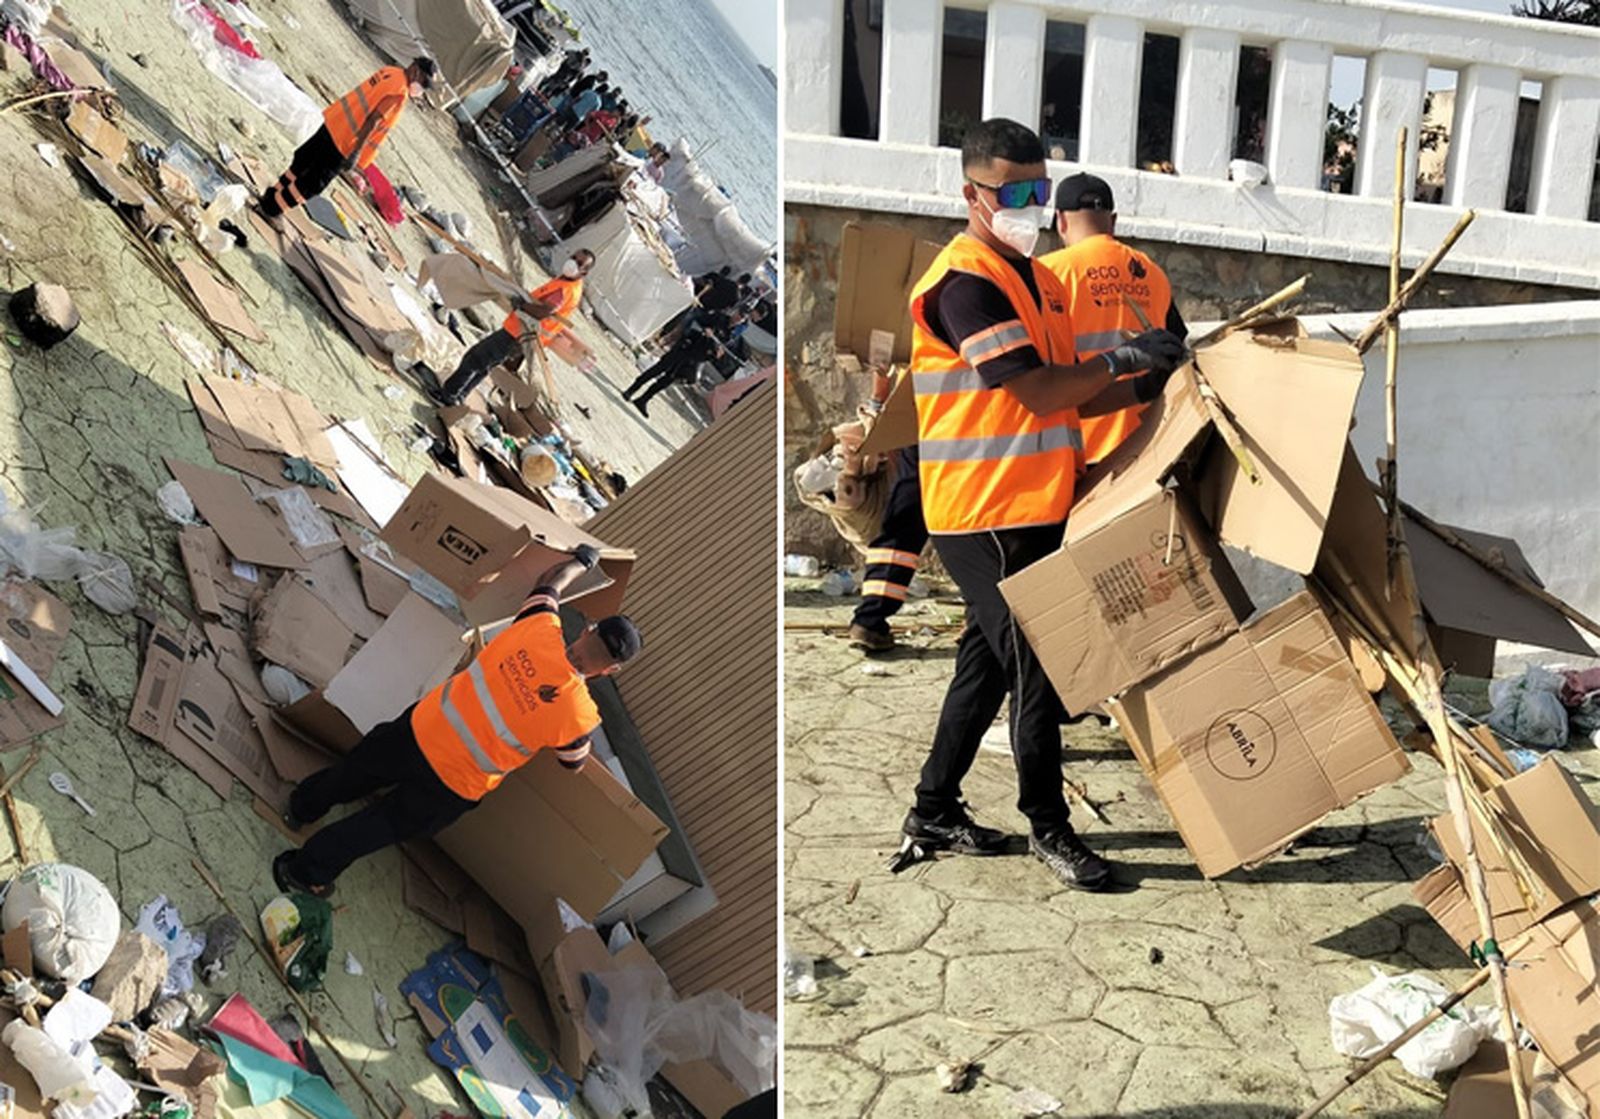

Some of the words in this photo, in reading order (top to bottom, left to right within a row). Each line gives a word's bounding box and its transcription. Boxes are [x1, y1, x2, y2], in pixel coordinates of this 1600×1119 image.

[1086, 265, 1119, 280] eco
[446, 533, 480, 561] IKEA
[517, 650, 536, 678] eco
